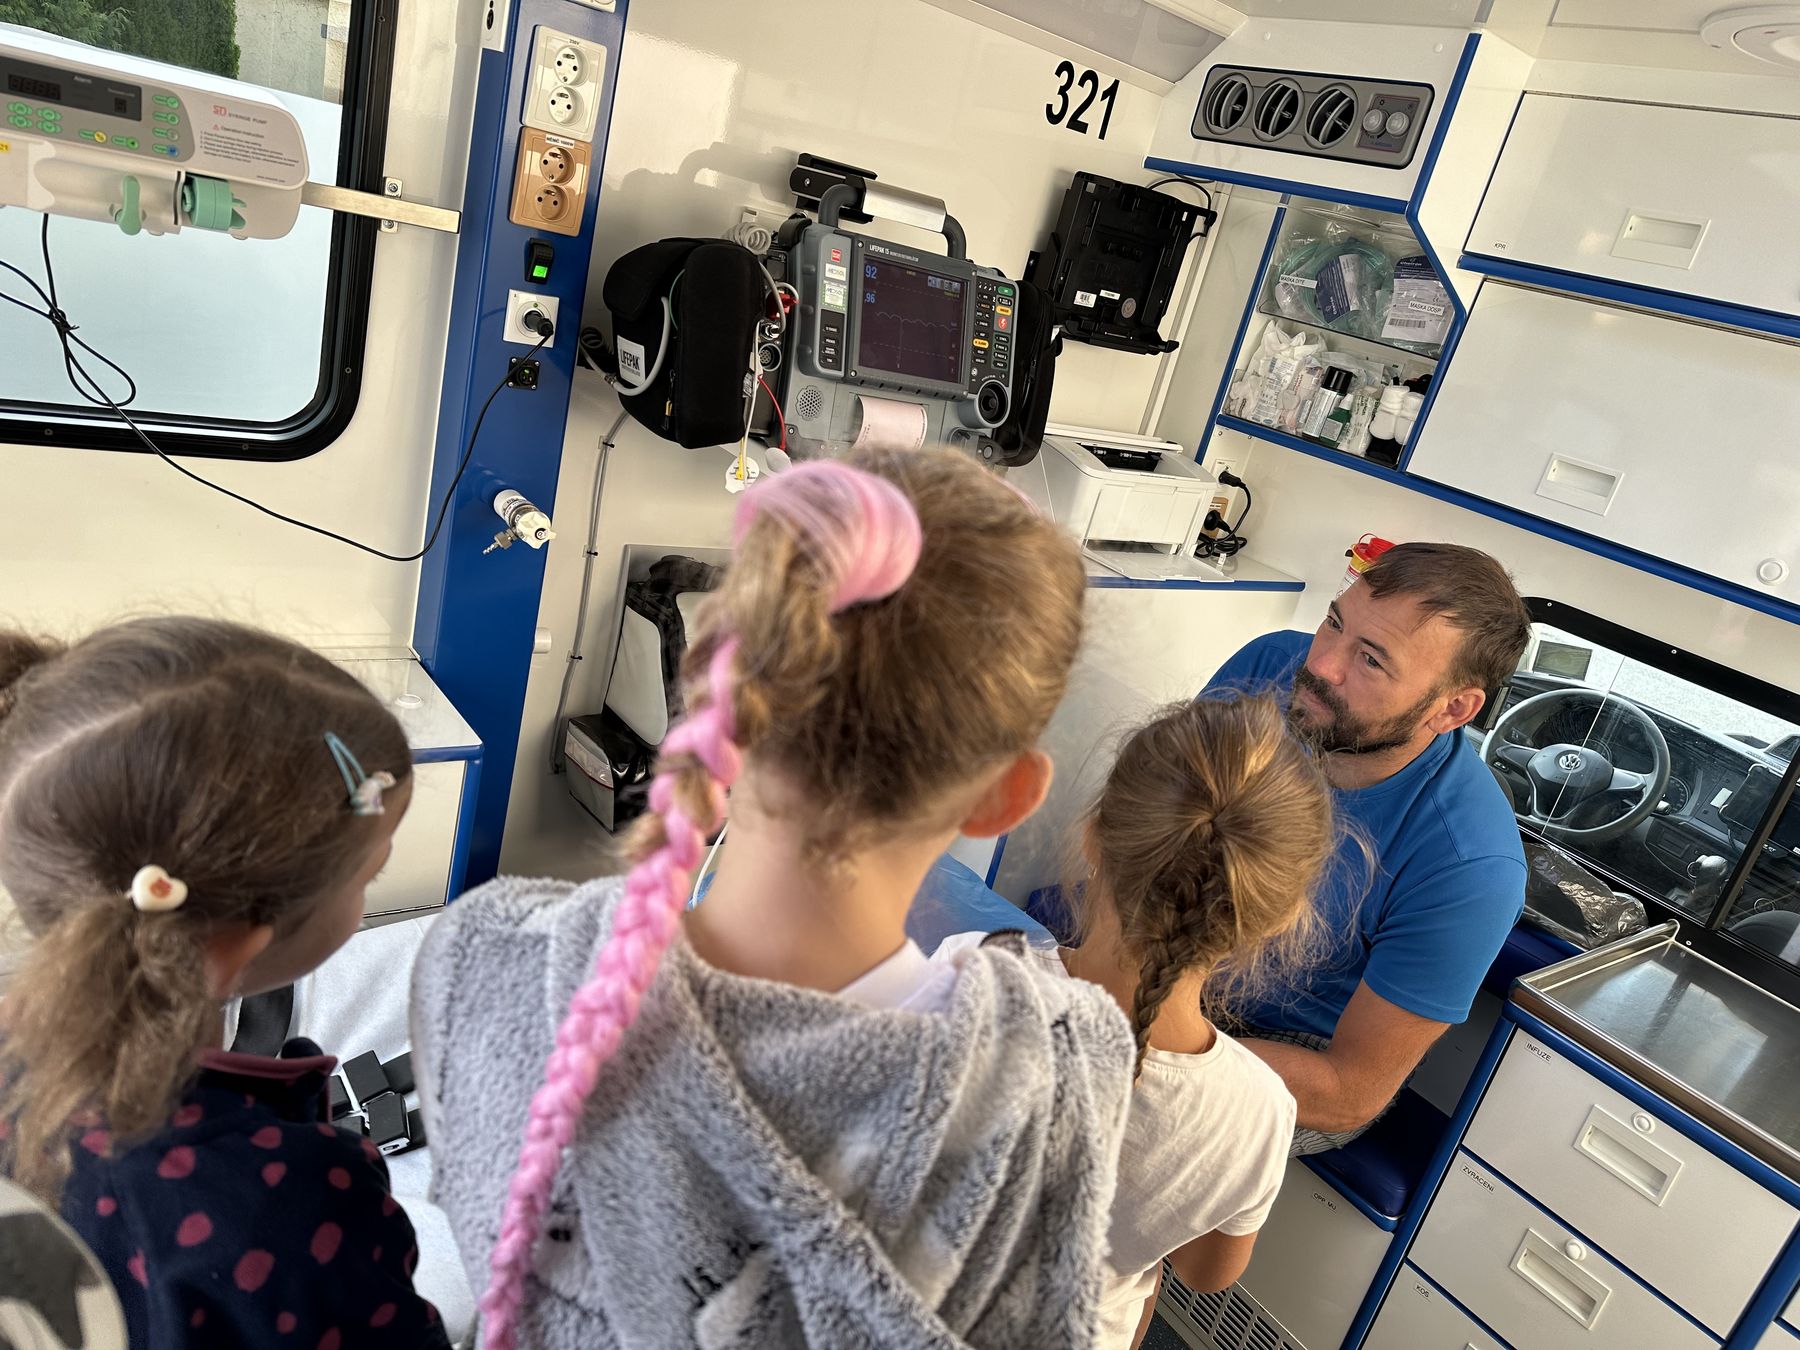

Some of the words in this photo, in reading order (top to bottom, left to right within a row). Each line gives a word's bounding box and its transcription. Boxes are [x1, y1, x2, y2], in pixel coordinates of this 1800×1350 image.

[1045, 60, 1120, 140] 321
[869, 244, 885, 254] LIFEPAK
[865, 264, 878, 279] 92
[1410, 302, 1427, 310] MASKA
[620, 348, 641, 371] LIFEPAK
[1526, 1042, 1552, 1062] INFUZE
